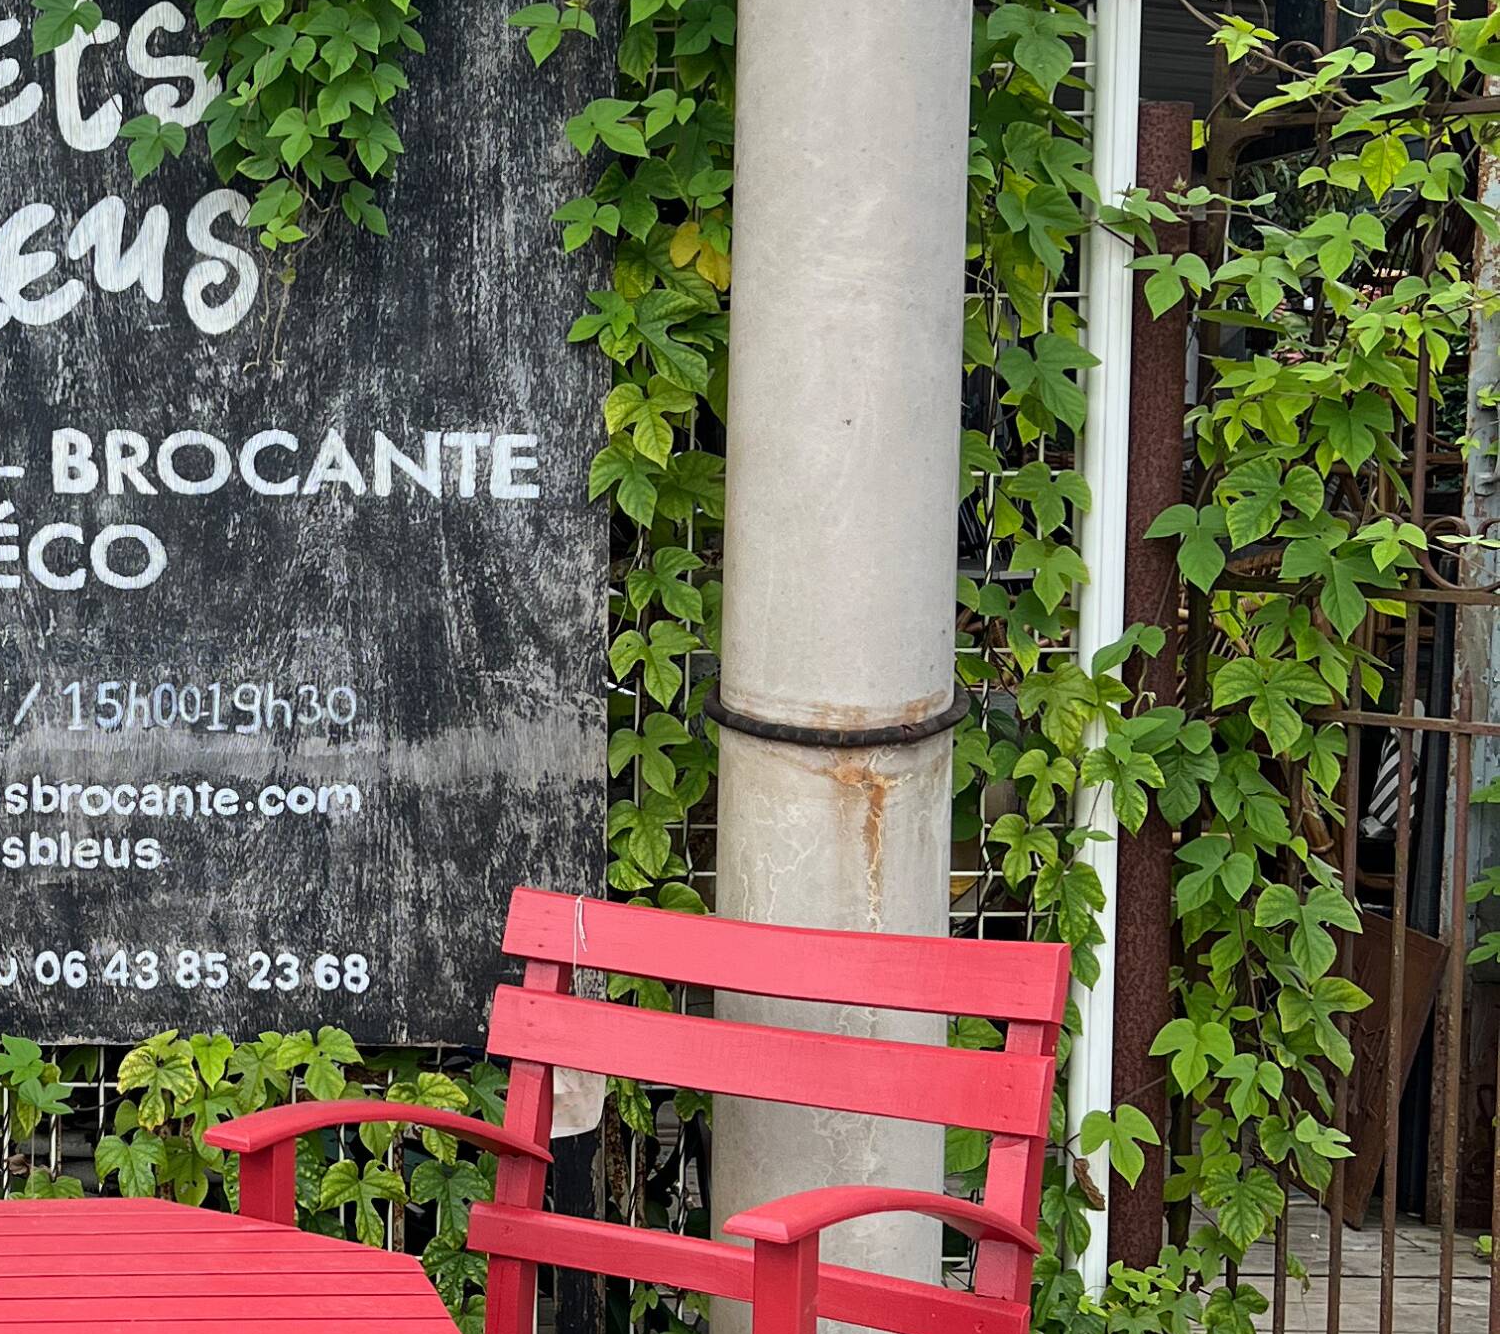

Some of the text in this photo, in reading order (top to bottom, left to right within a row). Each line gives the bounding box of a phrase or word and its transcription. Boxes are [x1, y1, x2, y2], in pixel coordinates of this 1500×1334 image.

[51, 427, 541, 500] BROCANTE
[35, 950, 88, 989] 06
[103, 949, 160, 990] 43
[174, 949, 230, 990] 85
[247, 951, 300, 992] 23
[313, 953, 370, 994] 68
